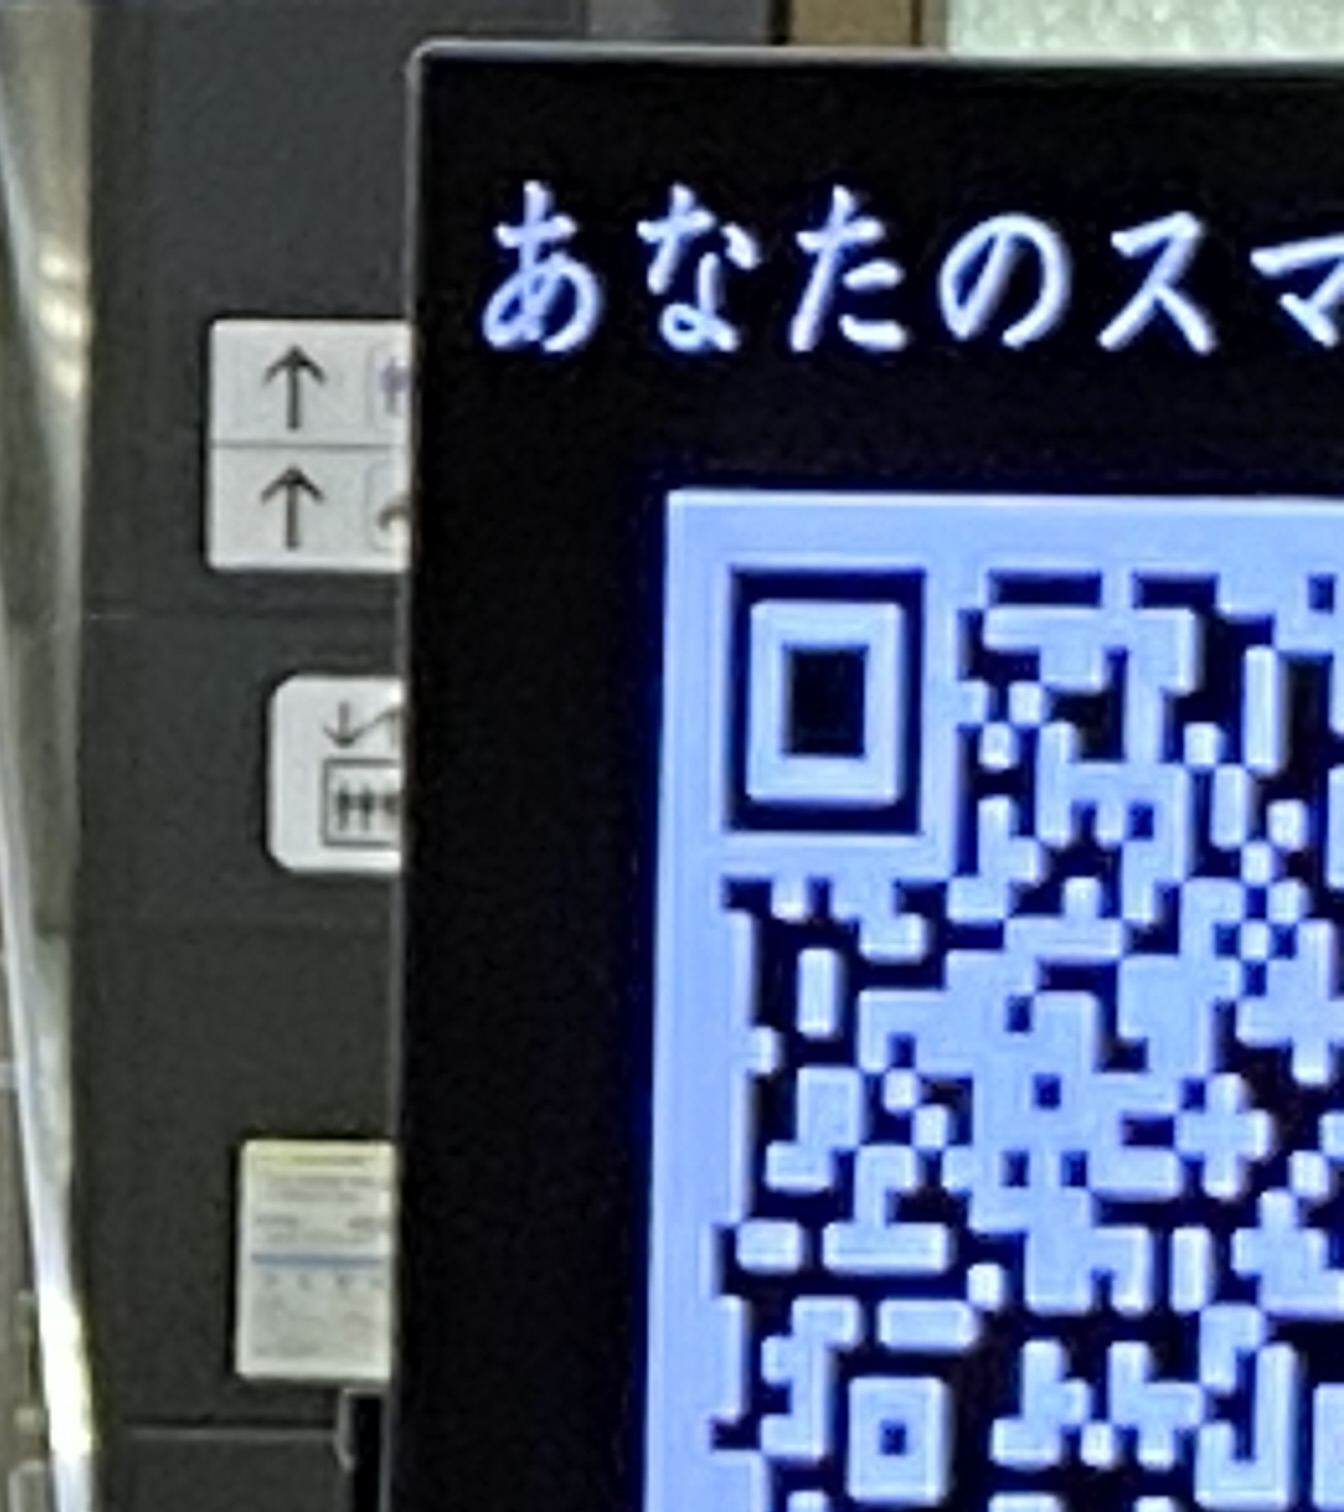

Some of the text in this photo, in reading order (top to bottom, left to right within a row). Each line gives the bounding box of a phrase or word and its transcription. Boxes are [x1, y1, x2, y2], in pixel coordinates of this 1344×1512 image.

[482, 180, 1344, 353] あなたのスマ
